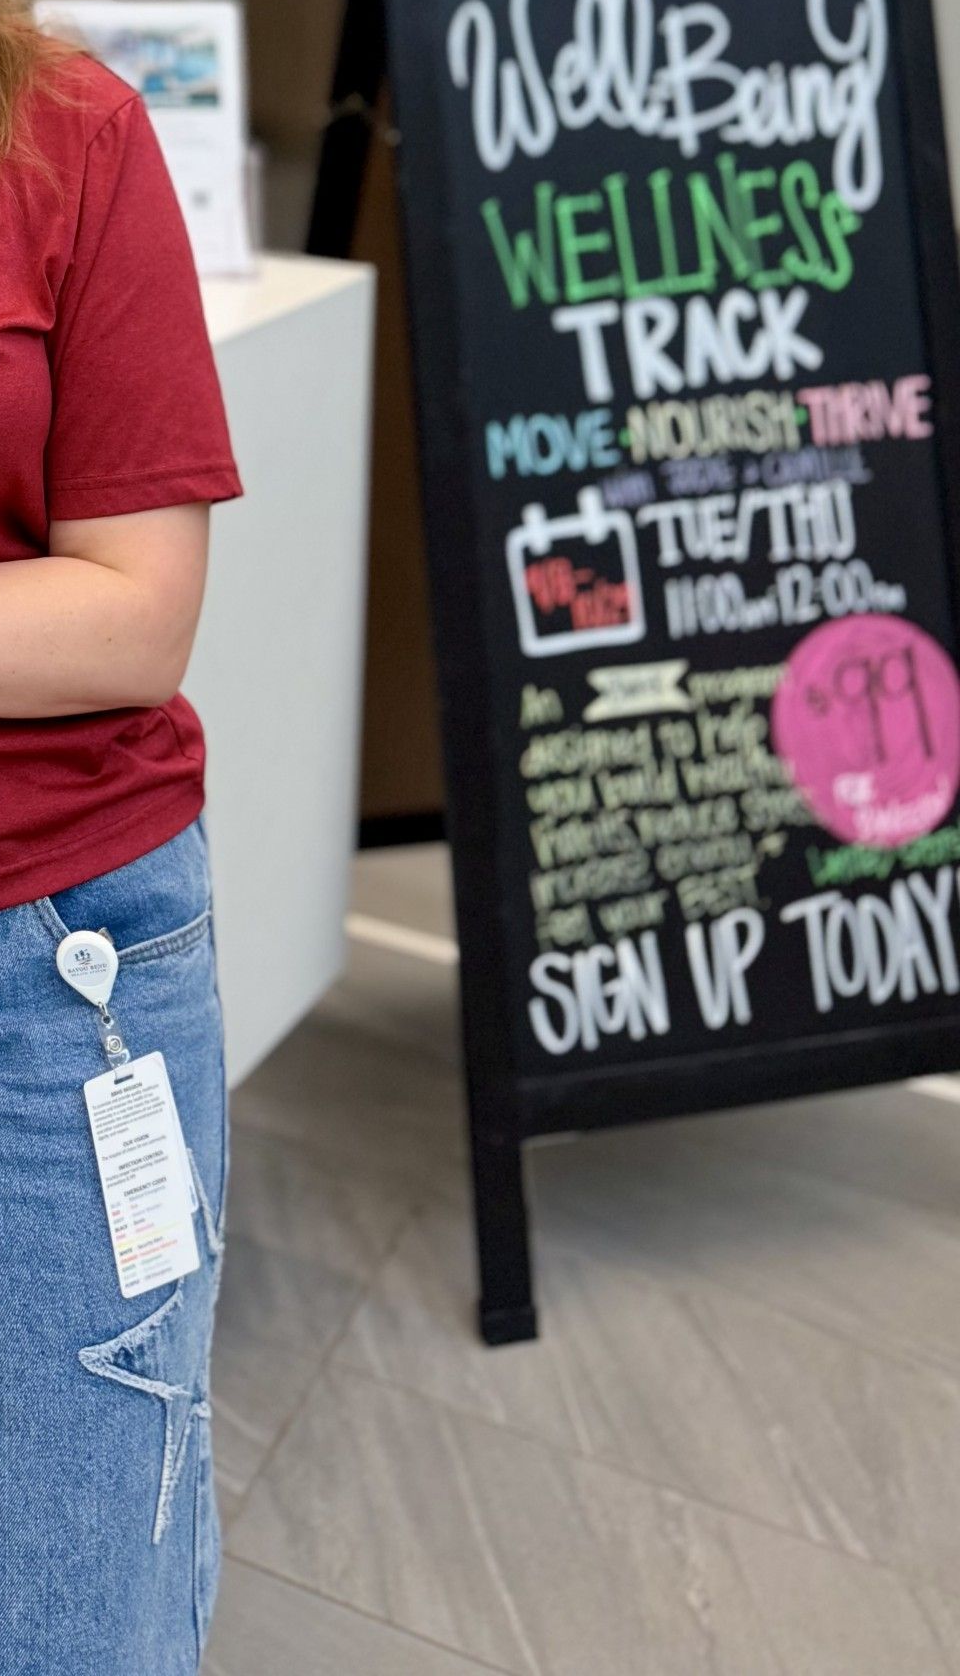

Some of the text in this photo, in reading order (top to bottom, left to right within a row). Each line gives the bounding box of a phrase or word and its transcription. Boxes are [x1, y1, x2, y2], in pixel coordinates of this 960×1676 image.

[482, 153, 861, 308] WELLNESS
[552, 288, 823, 402] TRACK
[485, 409, 621, 479] MOVE
[627, 389, 801, 463] NOURISH
[797, 374, 934, 448] THRIVE
[636, 480, 858, 568] TUE/THU
[528, 864, 960, 1055] SIGN UP TODAY
